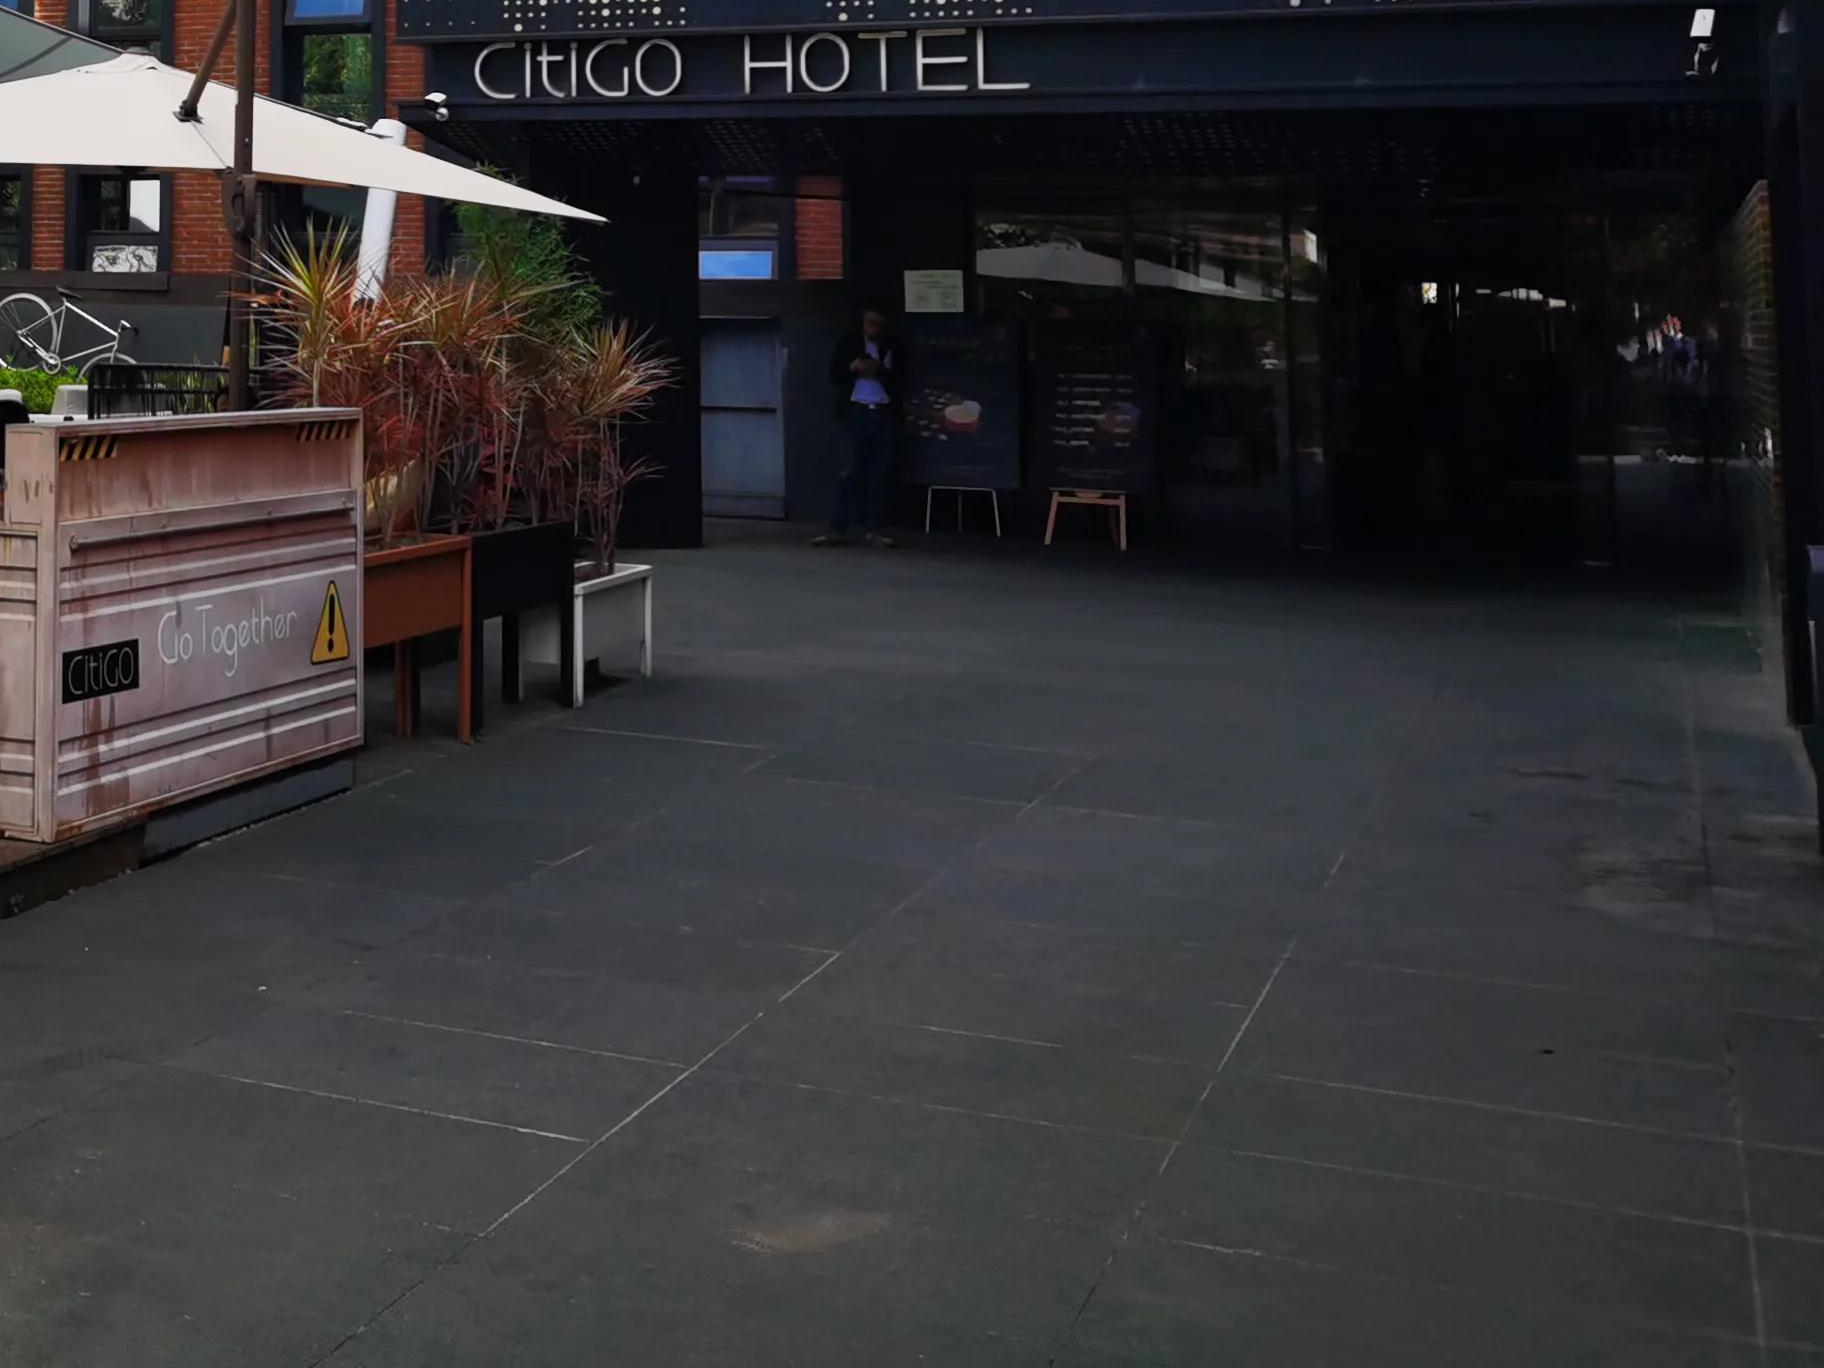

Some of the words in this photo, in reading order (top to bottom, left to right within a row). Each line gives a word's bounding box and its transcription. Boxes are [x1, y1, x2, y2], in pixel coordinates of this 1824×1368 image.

[474, 38, 682, 100] CitiGO
[743, 26, 1031, 95] HOTEL
[68, 646, 135, 696] CitiGO
